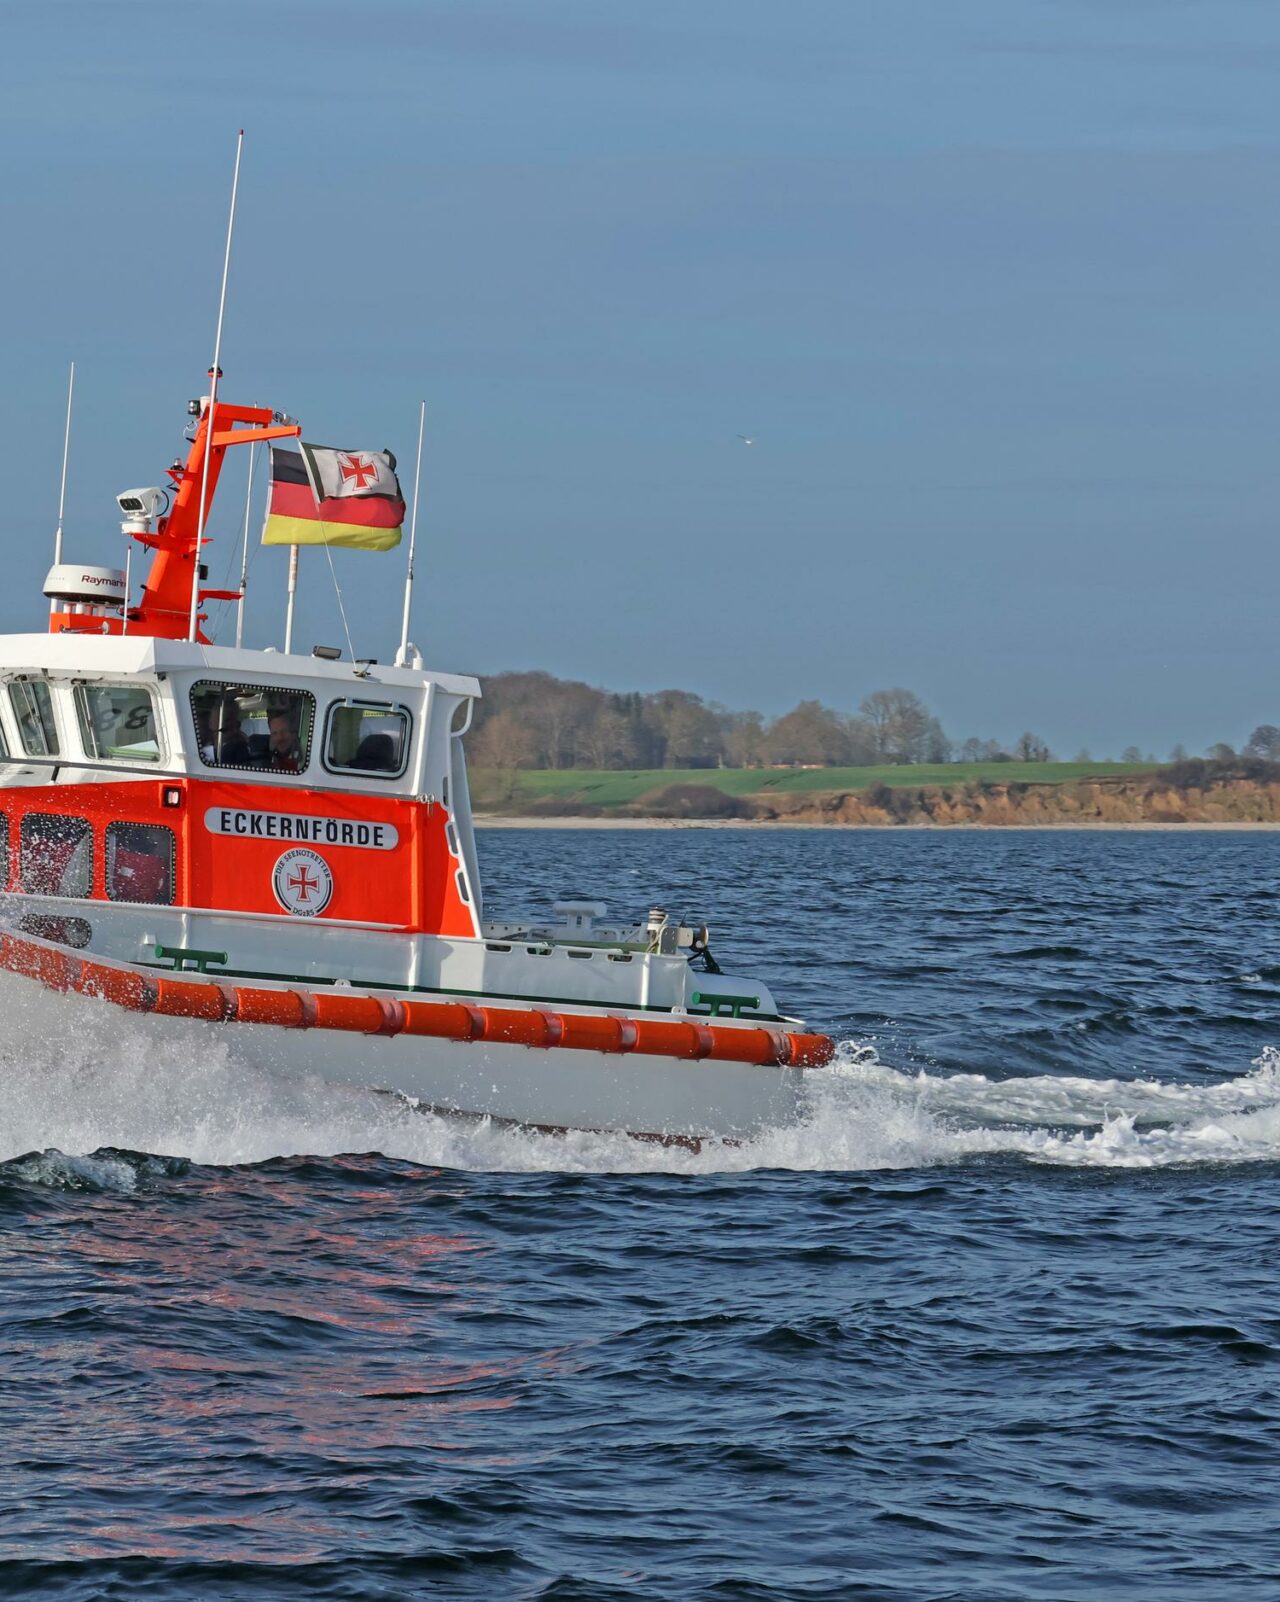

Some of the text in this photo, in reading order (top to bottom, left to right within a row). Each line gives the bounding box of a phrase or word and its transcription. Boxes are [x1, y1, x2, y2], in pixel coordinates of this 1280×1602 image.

[220, 811, 384, 847] ECKERNFÖRDE
[276, 849, 331, 878] DIE SEENOTRETTER
